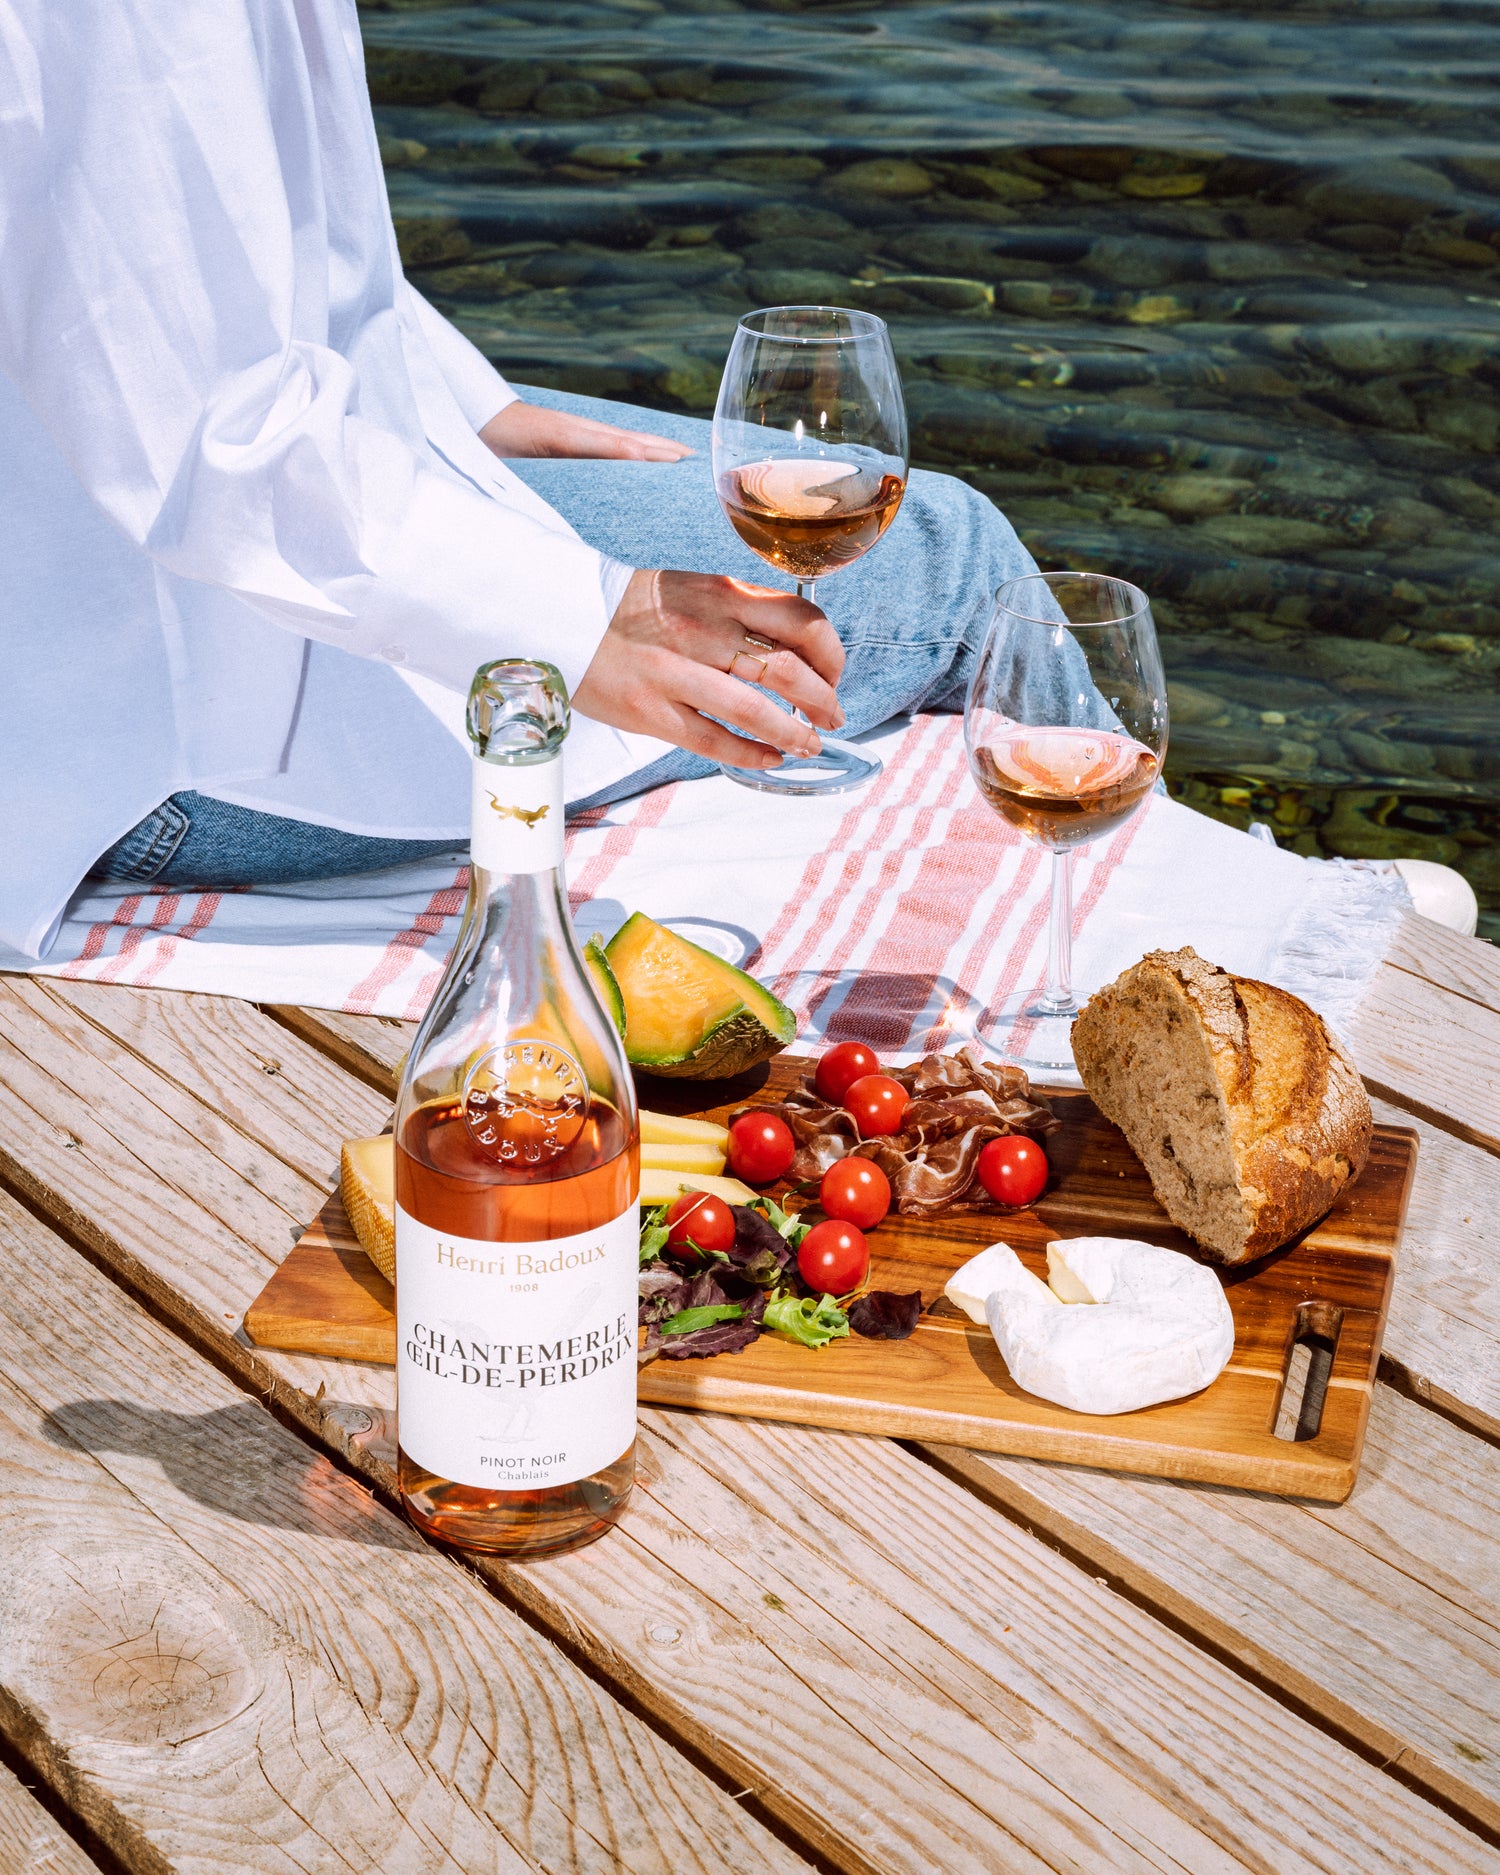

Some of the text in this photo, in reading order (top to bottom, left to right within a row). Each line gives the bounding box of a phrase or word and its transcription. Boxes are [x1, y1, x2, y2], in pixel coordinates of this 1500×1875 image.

[504, 1046, 578, 1088] HENRI
[468, 1088, 565, 1162] BADOUX
[437, 1243, 606, 1275] Henri Badoux
[509, 1283, 539, 1293] 1908
[414, 1313, 627, 1365] CHANTEMERLE
[406, 1330, 632, 1388] ŒIL-DE-PERDRIX
[480, 1452, 567, 1469] PINOT NOIR
[497, 1470, 549, 1480] Chablais
